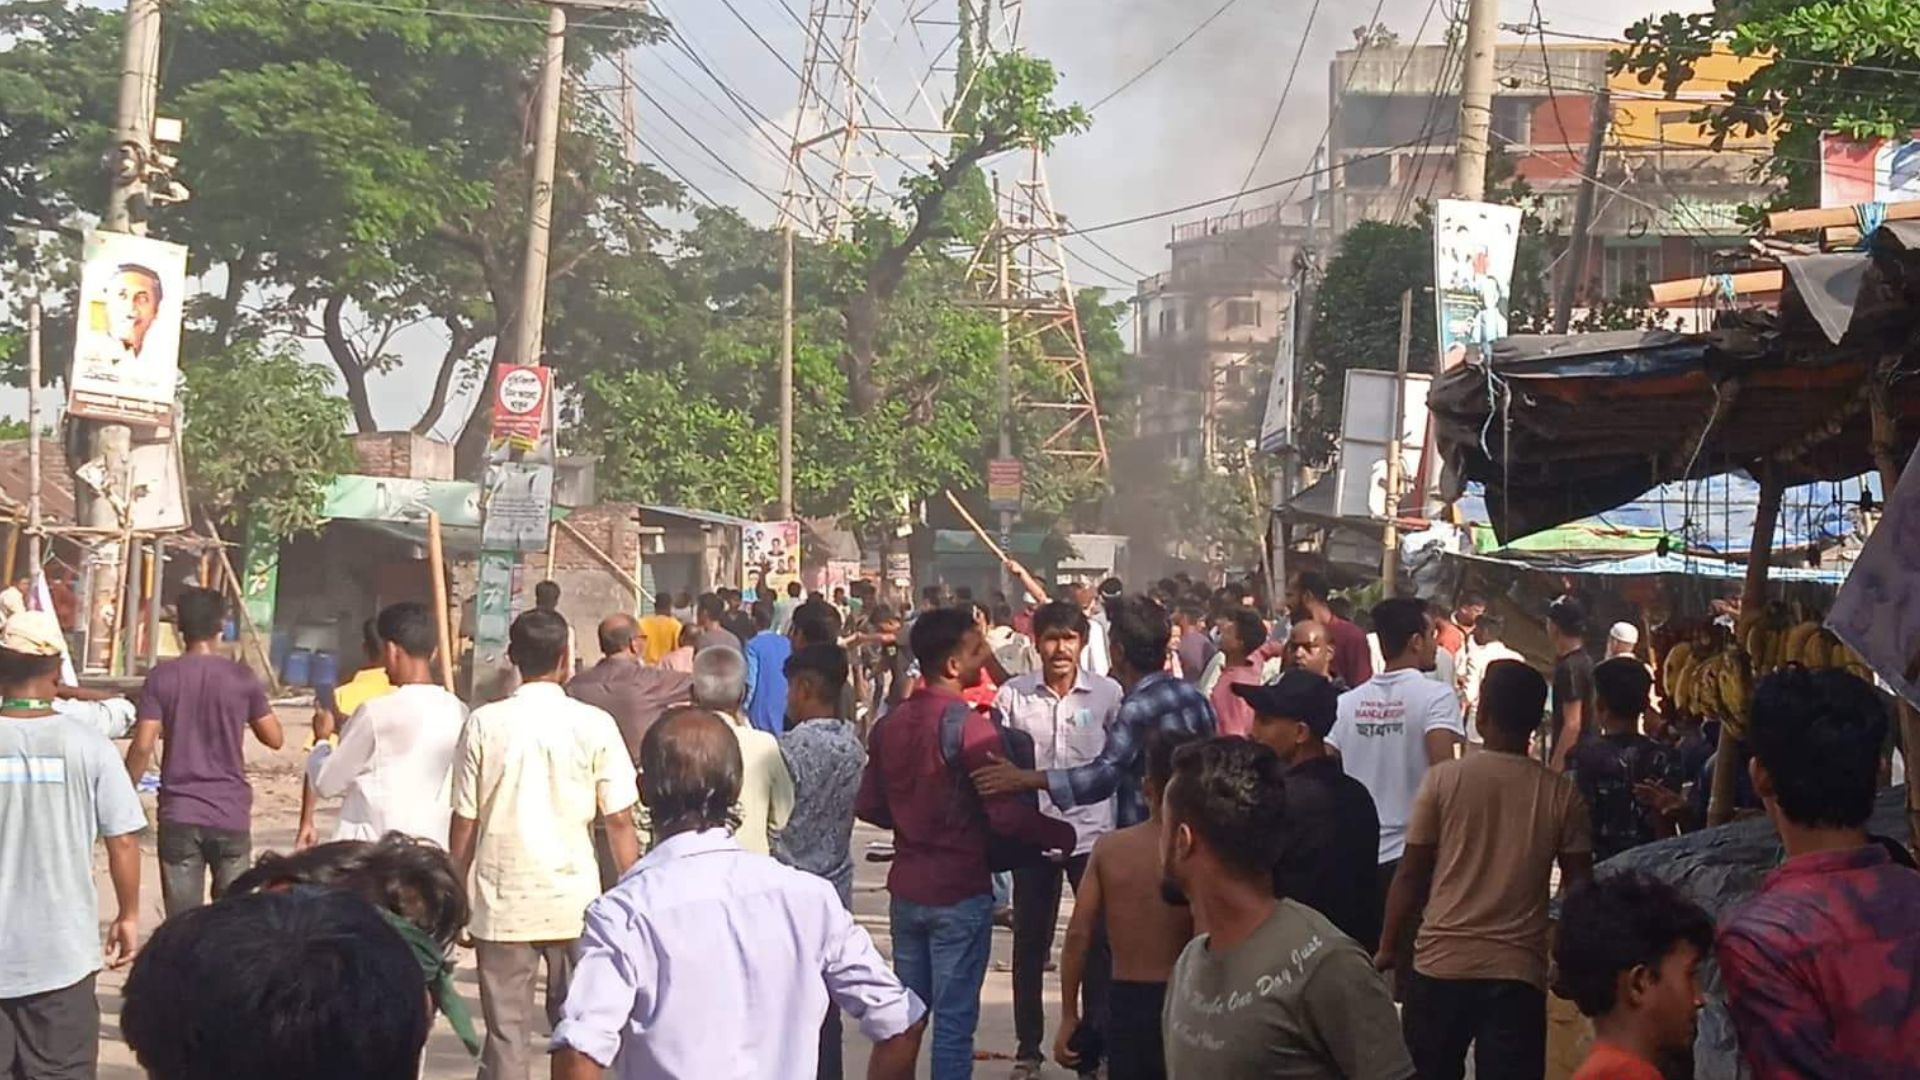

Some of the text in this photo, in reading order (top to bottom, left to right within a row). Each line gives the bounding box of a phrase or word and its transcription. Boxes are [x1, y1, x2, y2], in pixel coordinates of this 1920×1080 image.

[1227, 989, 1254, 1011] One
[1256, 969, 1293, 997] Day
[1290, 935, 1323, 972] Just
